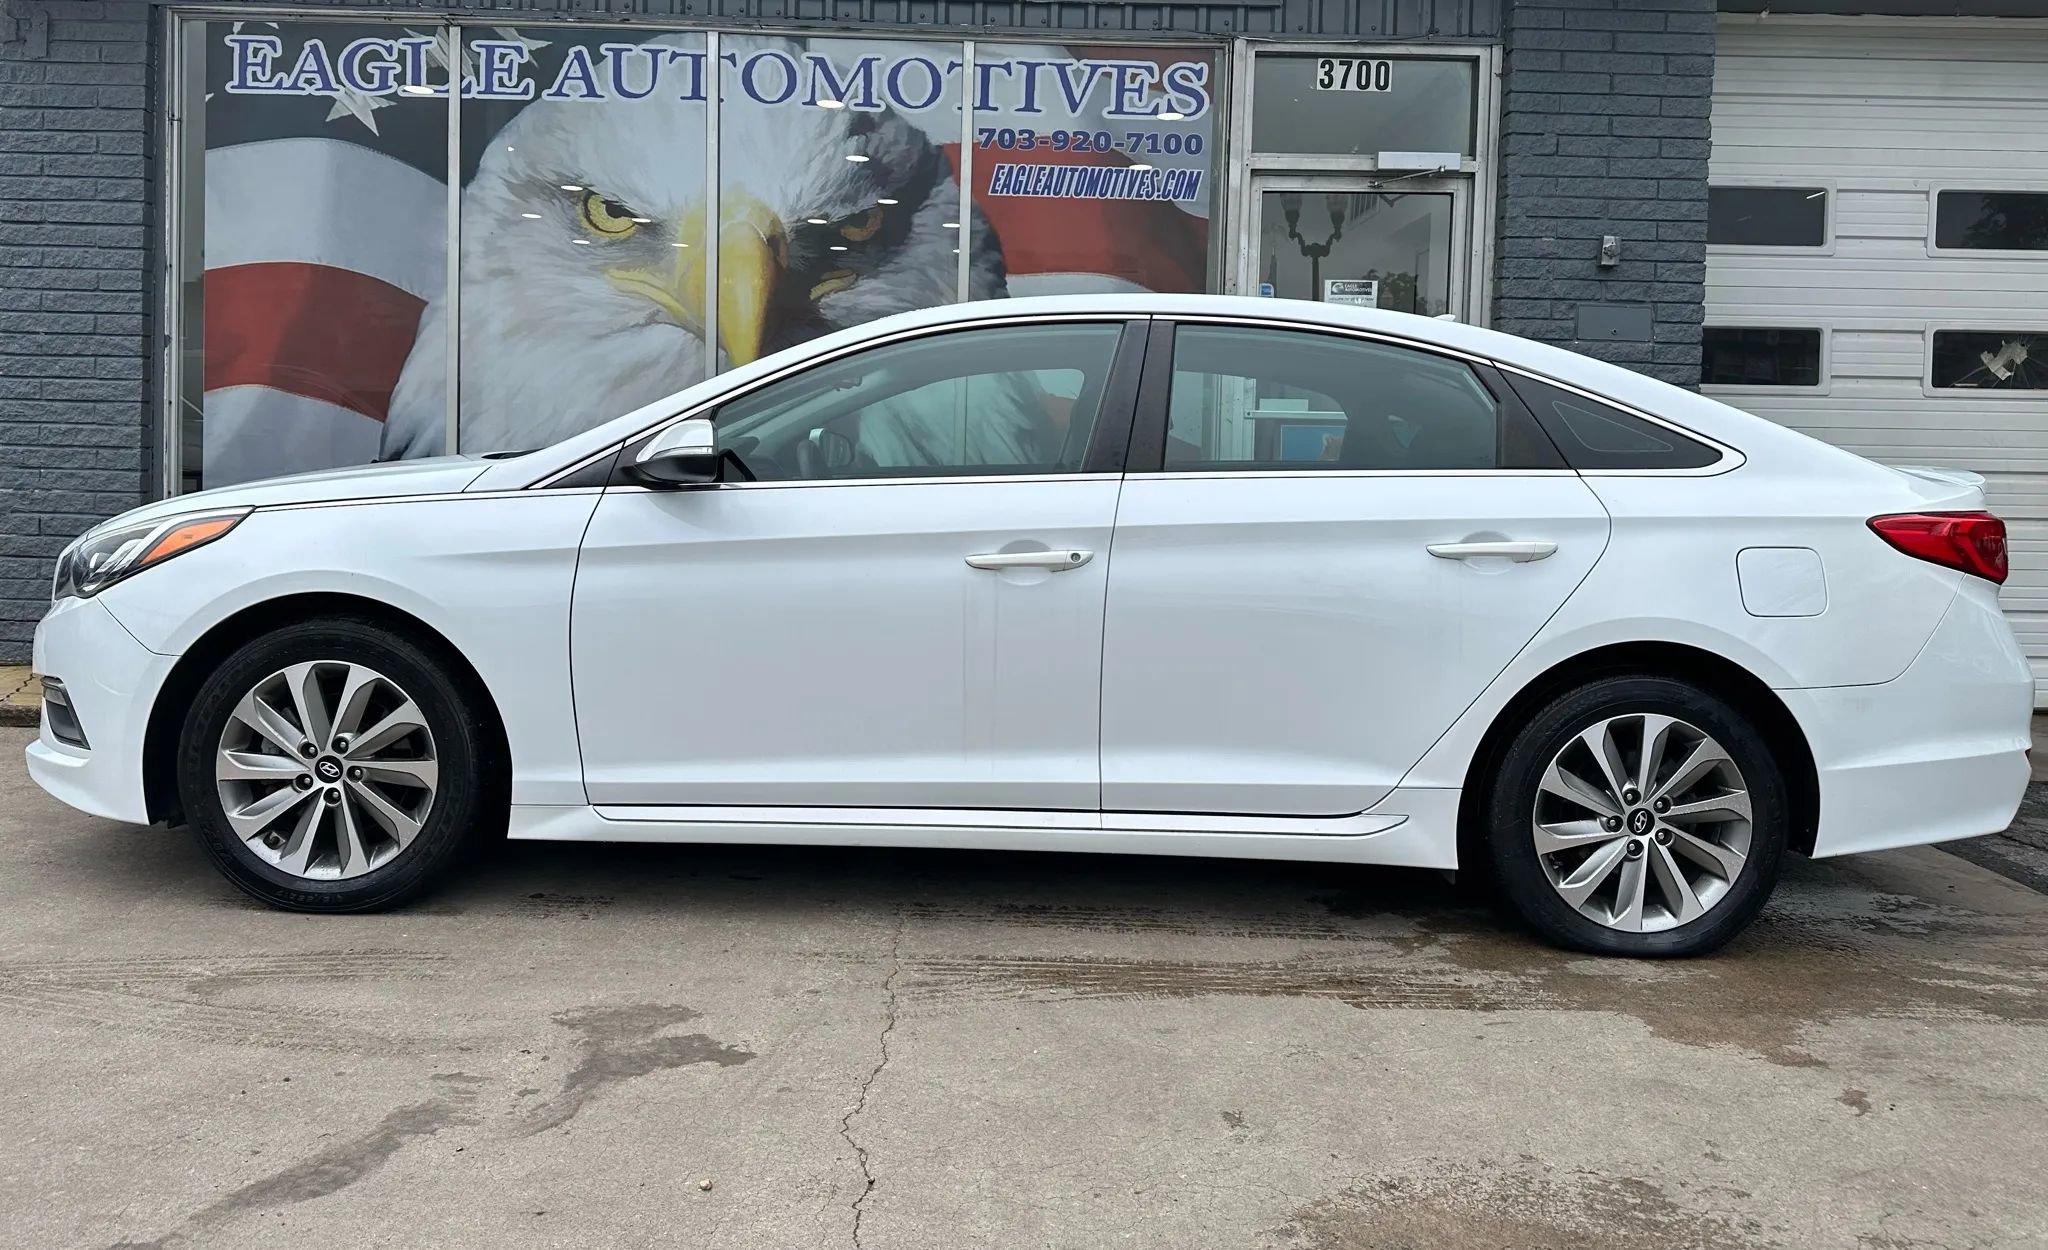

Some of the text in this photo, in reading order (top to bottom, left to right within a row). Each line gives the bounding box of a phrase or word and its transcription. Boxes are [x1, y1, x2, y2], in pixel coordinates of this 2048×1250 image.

[226, 35, 1207, 117] EAGLE AUTOMOTIVES
[1318, 59, 1391, 91] 3700
[978, 127, 1204, 155] 703-920-7100
[989, 164, 1203, 201] EAGLEAUTOMOTIVES.COM
